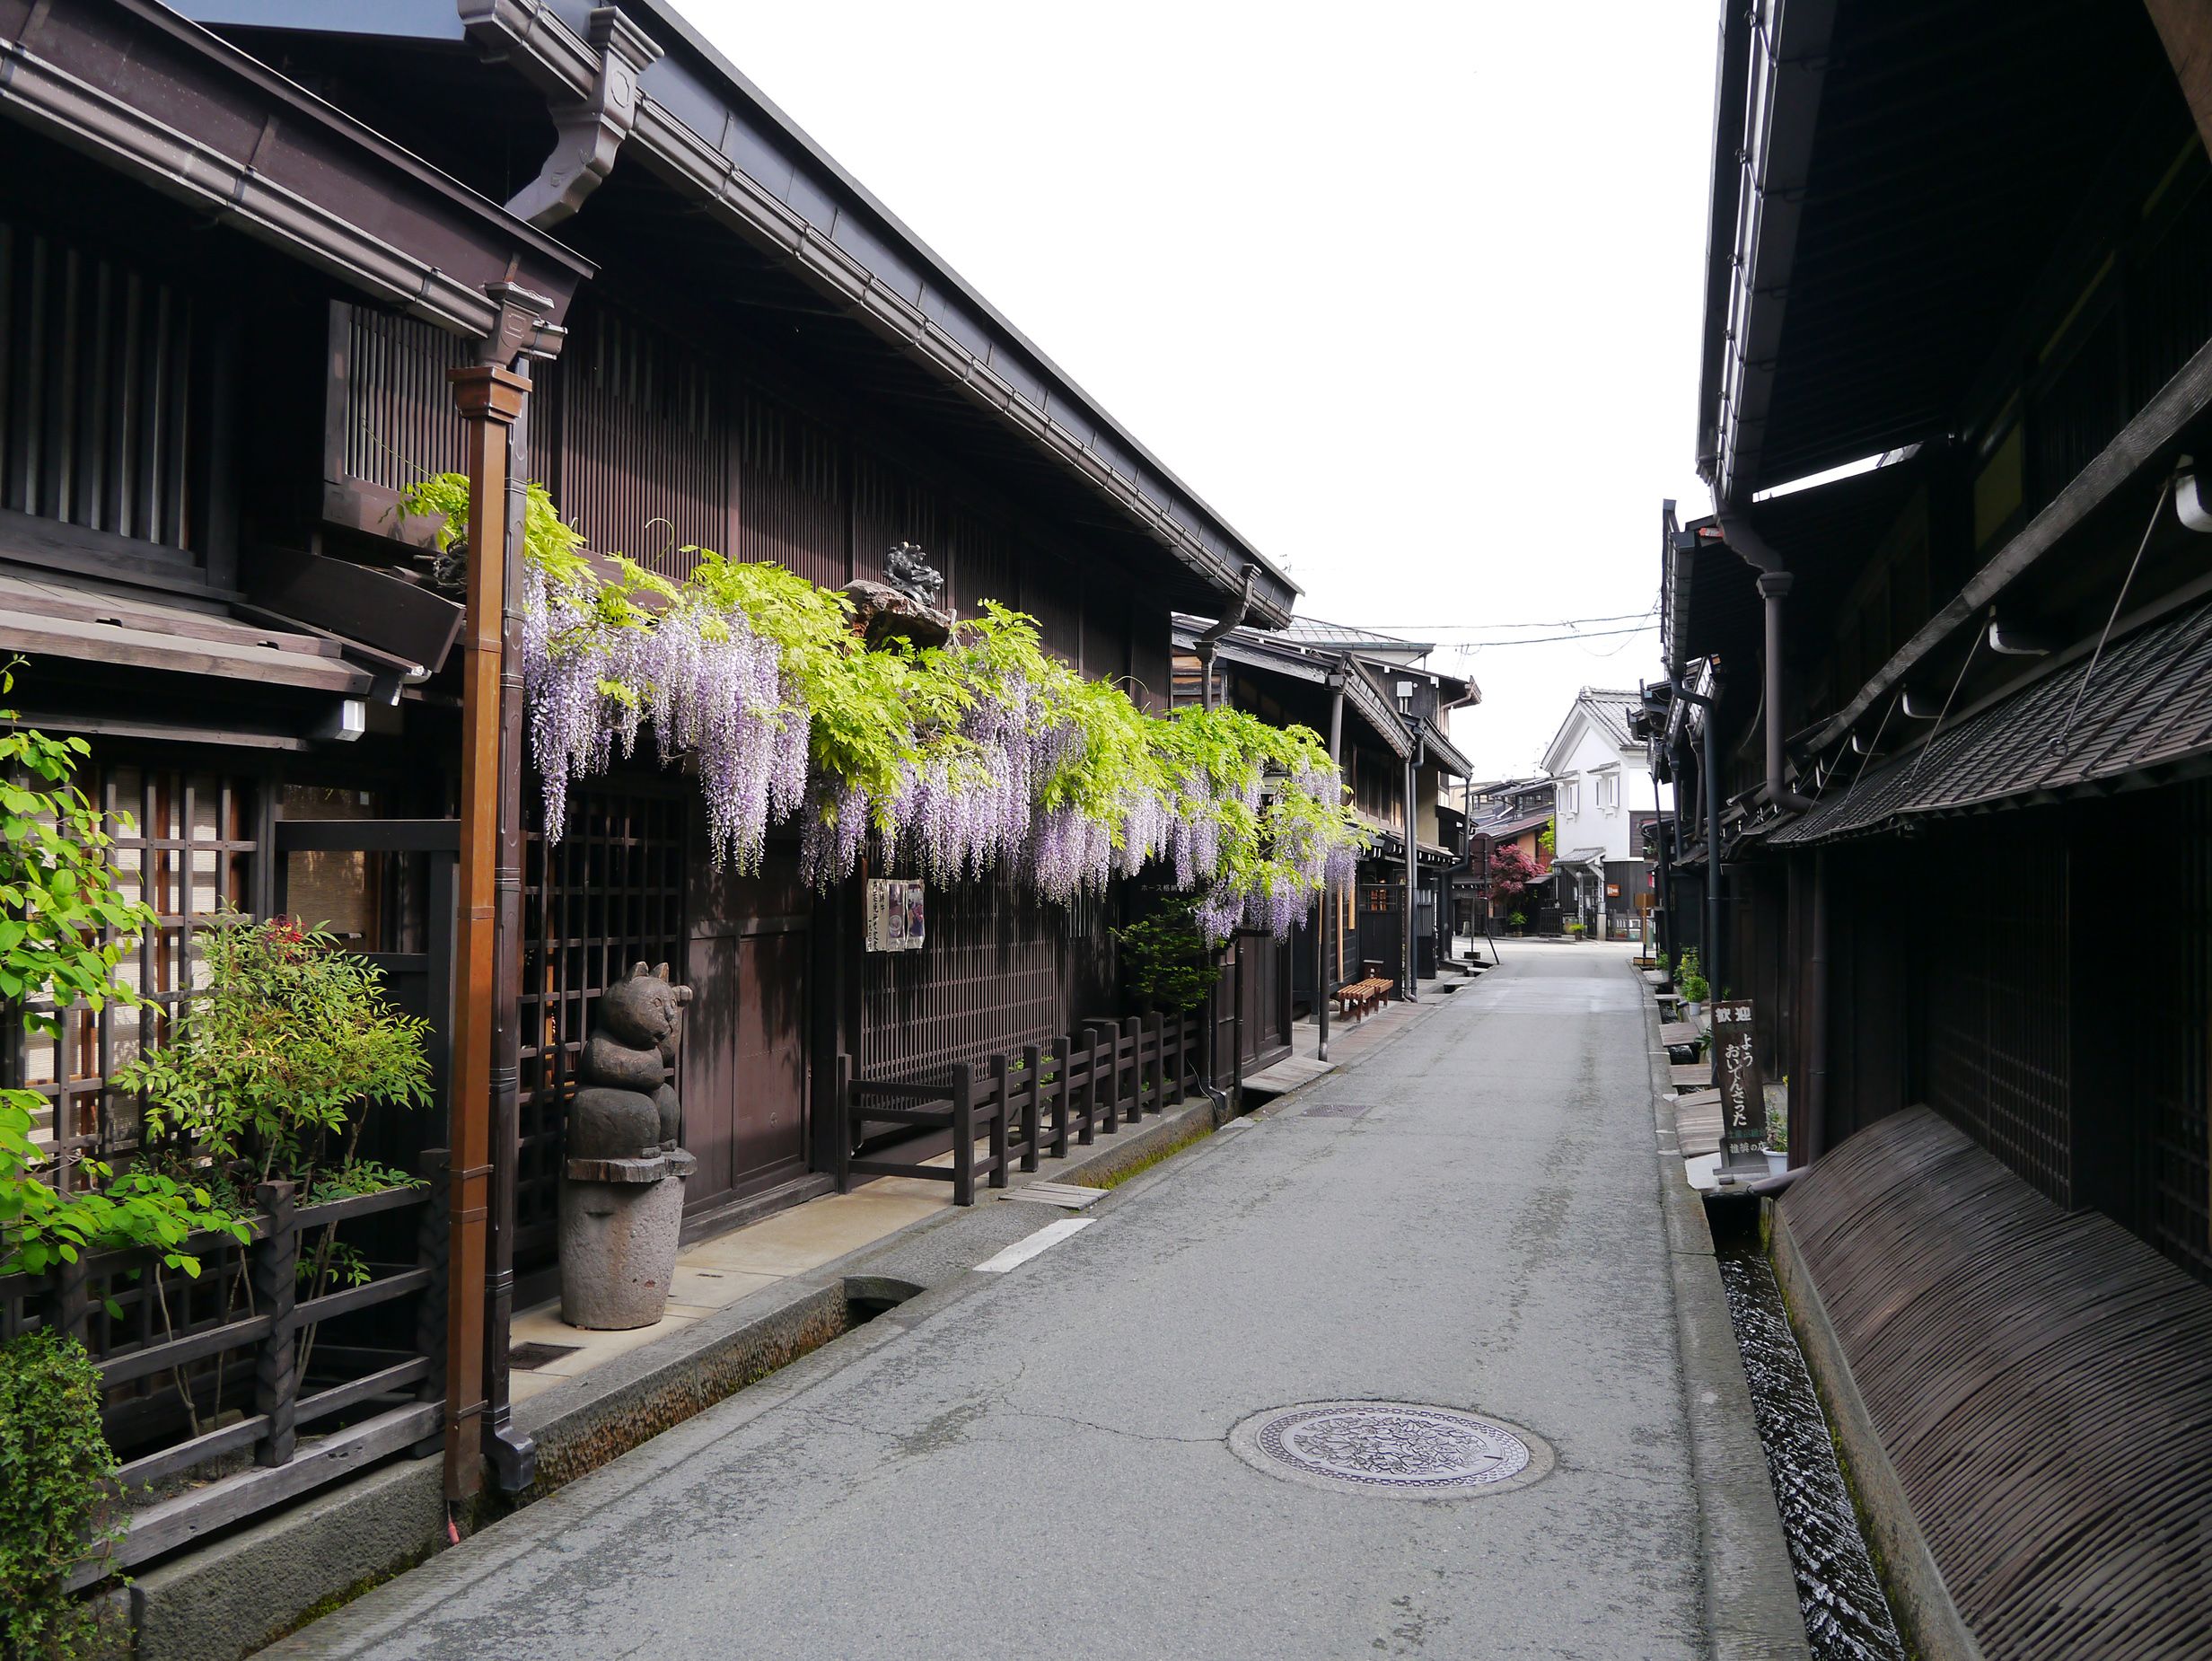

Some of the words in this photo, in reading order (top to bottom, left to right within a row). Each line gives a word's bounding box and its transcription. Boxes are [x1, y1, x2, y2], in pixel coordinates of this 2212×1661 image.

[1715, 1006, 1752, 1024] 歓迎
[1740, 1033, 1753, 1067] よう
[1725, 1043, 1747, 1127] おいでんさった
